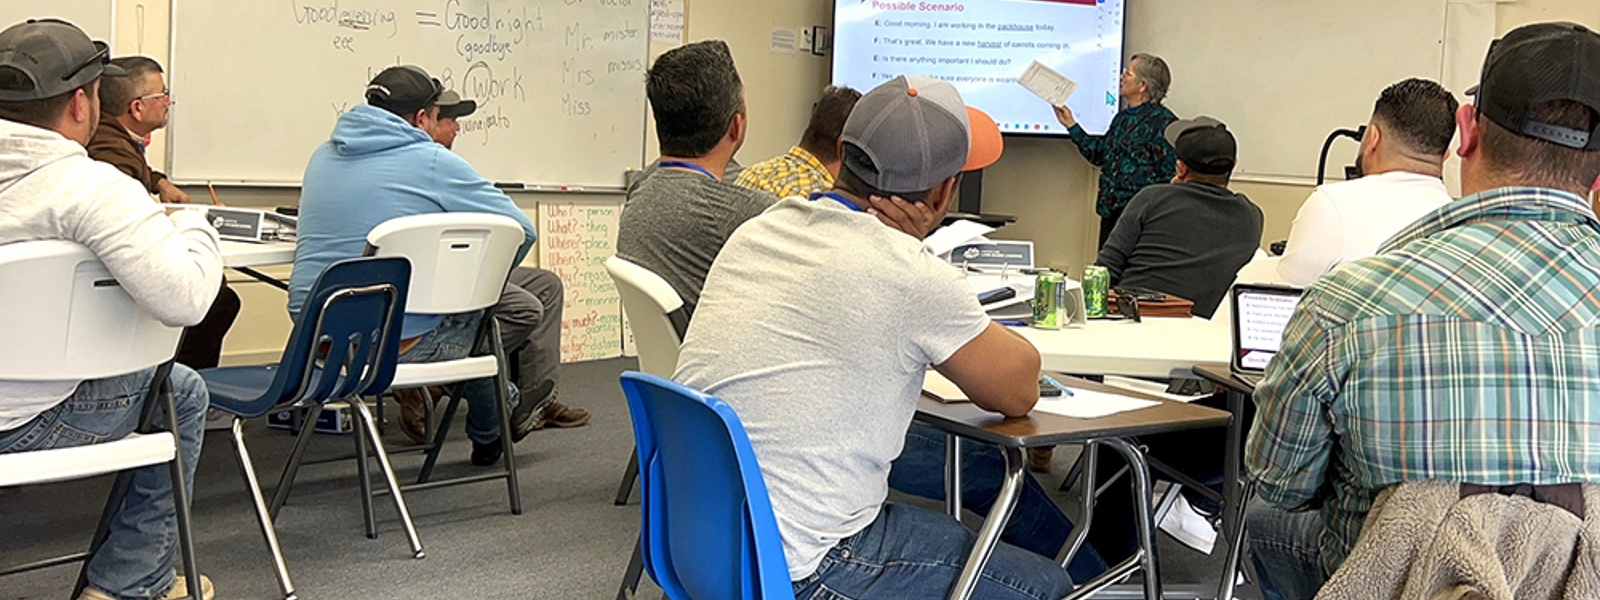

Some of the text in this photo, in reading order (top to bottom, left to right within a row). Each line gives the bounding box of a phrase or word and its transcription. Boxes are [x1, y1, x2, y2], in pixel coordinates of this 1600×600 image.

[872, 0, 965, 12] Possible Scenario
[445, 0, 491, 30] Good
[495, 6, 543, 45] night
[884, 20, 902, 28] Good
[950, 22, 976, 30] working
[997, 23, 1034, 32] packhouse
[564, 22, 594, 51] Mr.
[977, 40, 1002, 48] harvest
[909, 56, 936, 65] anything
[938, 57, 969, 65] important
[956, 75, 986, 83] everyone
[547, 202, 575, 217] Who?
[547, 218, 578, 234] What?
[548, 234, 582, 249] Where?
[548, 250, 582, 267] When?
